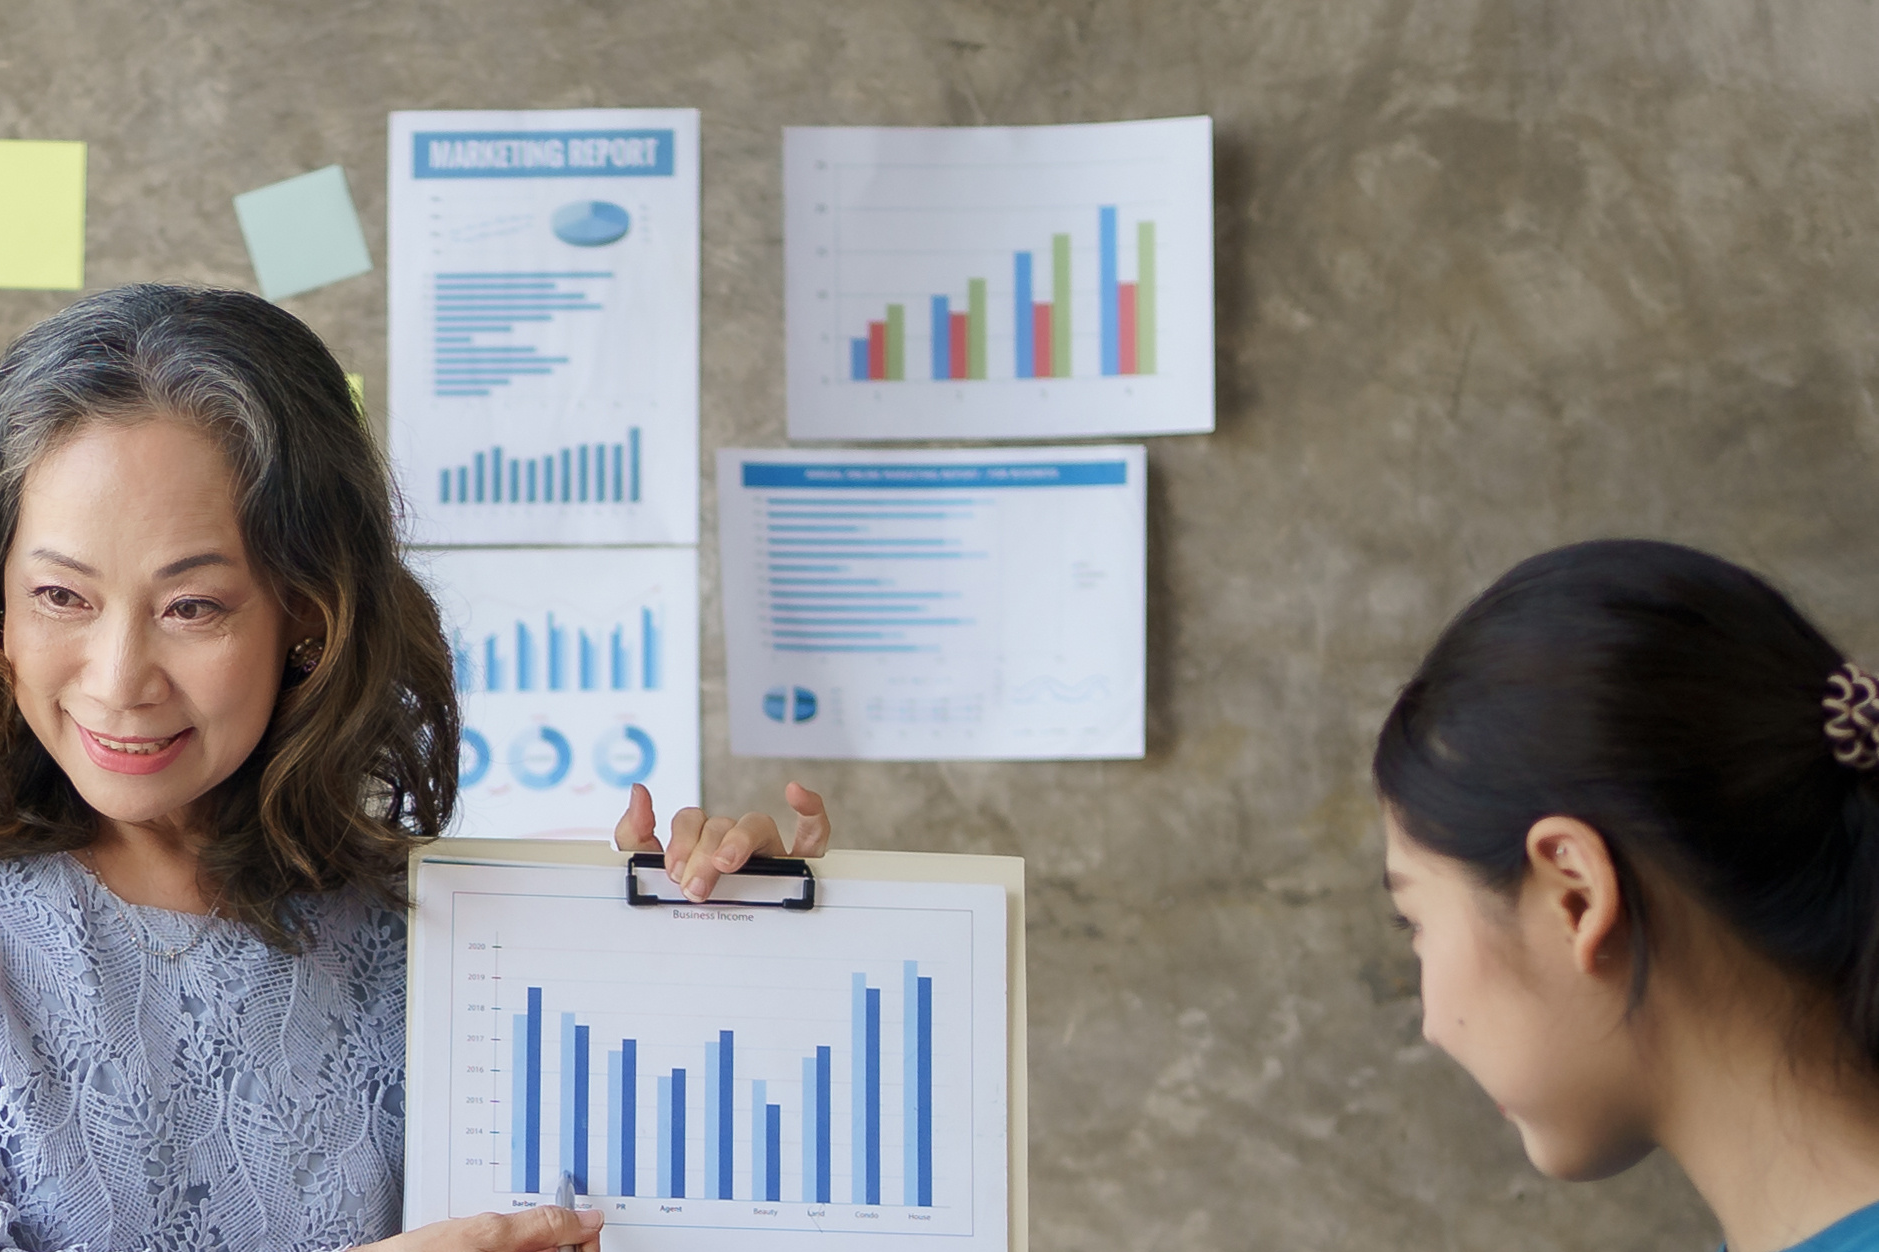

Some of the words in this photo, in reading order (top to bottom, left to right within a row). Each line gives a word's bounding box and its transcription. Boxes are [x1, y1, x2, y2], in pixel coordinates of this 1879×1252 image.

[429, 140, 565, 168] MARKETING
[568, 138, 658, 167] REPORT
[673, 909, 715, 920] Business
[717, 911, 754, 921] Income
[467, 1004, 485, 1012] 2018
[467, 1035, 484, 1043] 2017
[512, 1199, 537, 1207] Barber
[659, 1204, 682, 1213] Agent
[753, 1207, 778, 1217] Beauty
[855, 1210, 879, 1219] Condo
[908, 1213, 931, 1221] House
